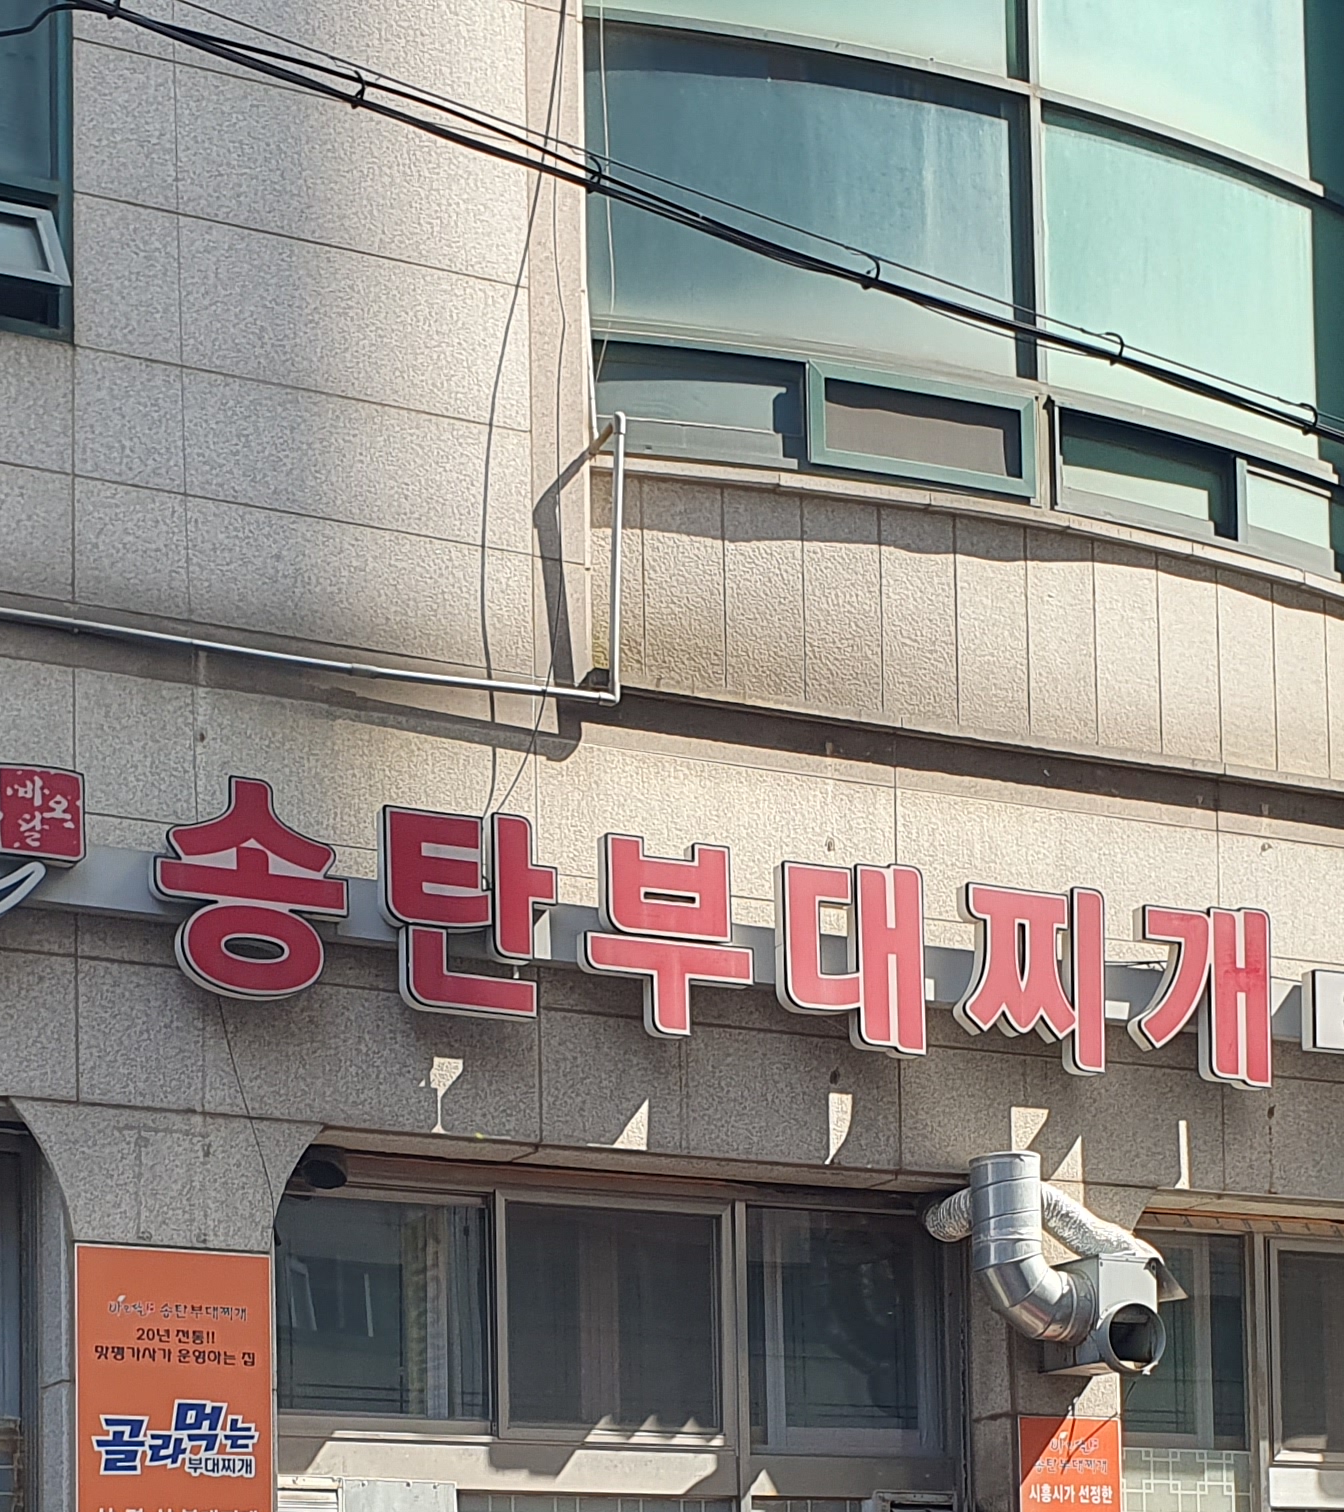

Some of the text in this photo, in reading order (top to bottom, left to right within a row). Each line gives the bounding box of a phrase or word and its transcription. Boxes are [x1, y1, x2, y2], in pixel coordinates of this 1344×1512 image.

[150, 776, 1272, 1089] 송탄부대찌개
[159, 1303, 248, 1322] 송탄부대찌개
[135, 1327, 216, 1345] 20년 전통!!
[94, 1345, 173, 1363] 맛평가사가
[241, 1350, 256, 1367] 집
[186, 1456, 255, 1475] 부대찌개
[1029, 1483, 1113, 1505] 시흥시가 선정한
